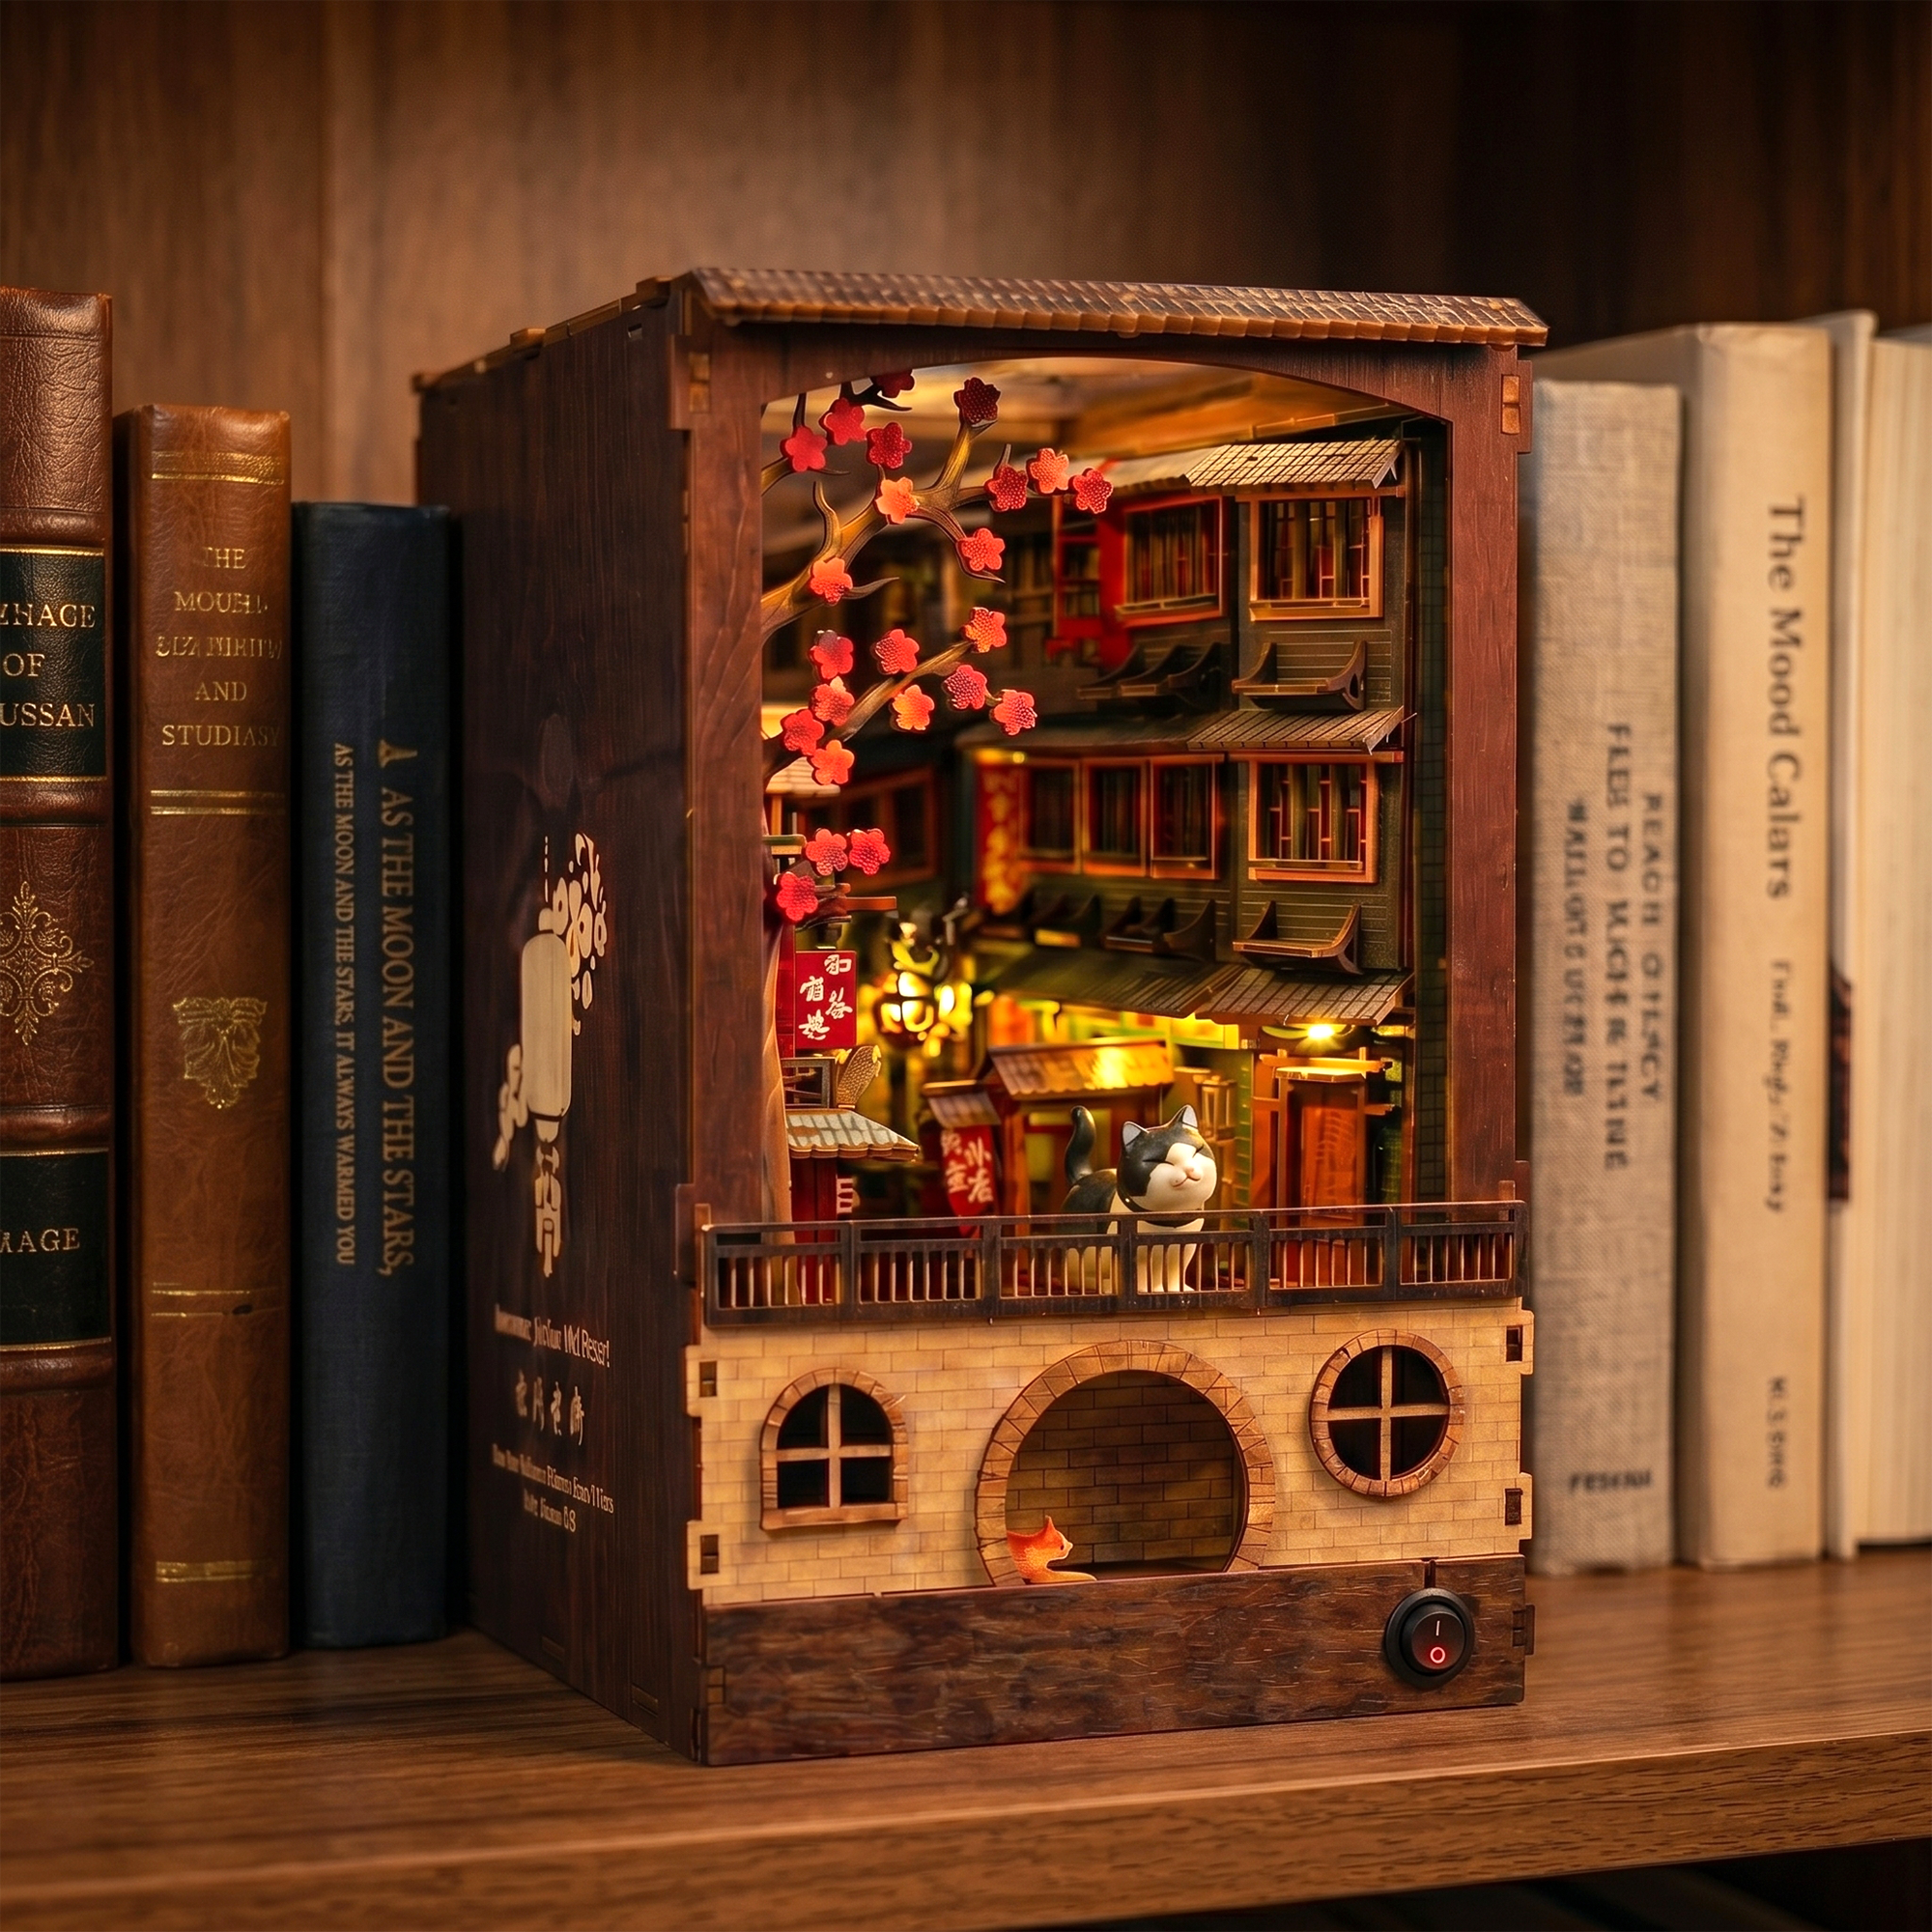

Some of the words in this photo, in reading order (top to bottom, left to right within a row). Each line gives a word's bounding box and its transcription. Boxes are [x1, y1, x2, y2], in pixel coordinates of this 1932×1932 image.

[1769, 495, 1806, 591] The
[3, 653, 45, 677] OF
[194, 681, 247, 701] AND
[1769, 608, 1804, 737] Mood
[335, 743, 354, 767] AS
[335, 770, 354, 809] THE
[382, 787, 413, 827] AS
[335, 813, 354, 874] MOON
[382, 832, 413, 896] THE
[335, 878, 355, 923] AND
[335, 925, 355, 962] THE
[382, 904, 413, 1009] MOON
[336, 1031, 355, 1051] IT
[383, 1015, 413, 1090] AND
[336, 1054, 355, 1130] ALWAYS
[383, 1094, 414, 1163] THE
[336, 1134, 355, 1222] WARMED
[336, 1224, 355, 1265] YOU
[376, 1169, 414, 1276] STARS,
